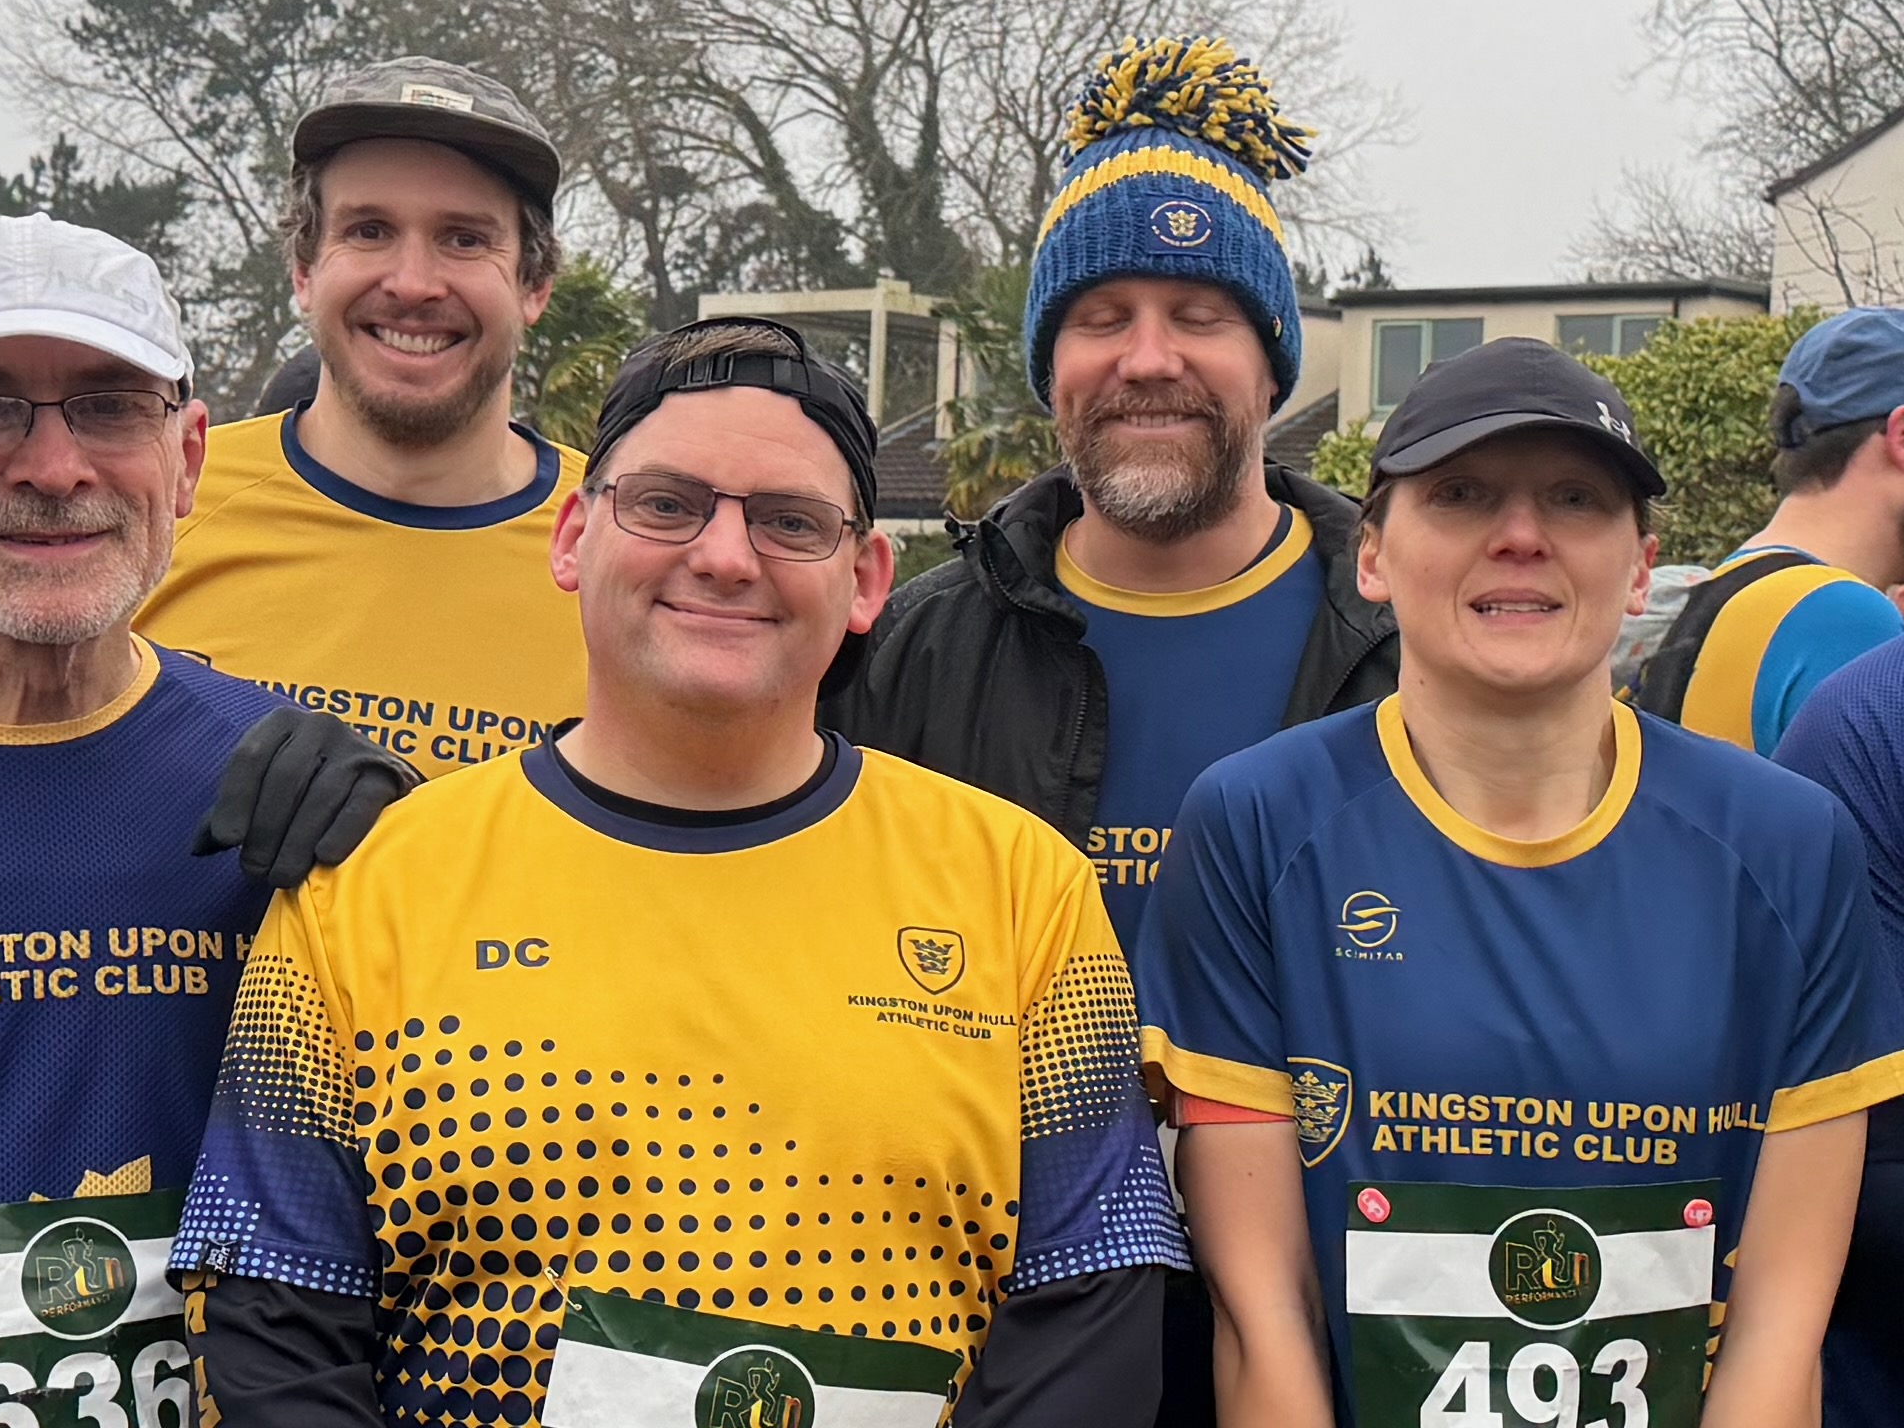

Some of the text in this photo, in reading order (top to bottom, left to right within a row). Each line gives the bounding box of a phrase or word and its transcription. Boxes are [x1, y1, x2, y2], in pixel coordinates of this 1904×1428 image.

[358, 724, 528, 764] TIC CLU
[109, 928, 223, 962] UPON
[476, 938, 550, 970] DC
[95, 966, 209, 997] CLUB
[848, 995, 1017, 1026] KINGSTON UPON HULL
[877, 1011, 992, 1039] ATHLETIC CLUB
[1369, 1091, 1767, 1134] KINGSTON UPON HULL
[1373, 1124, 1677, 1165] ATHLETIC CLUB
